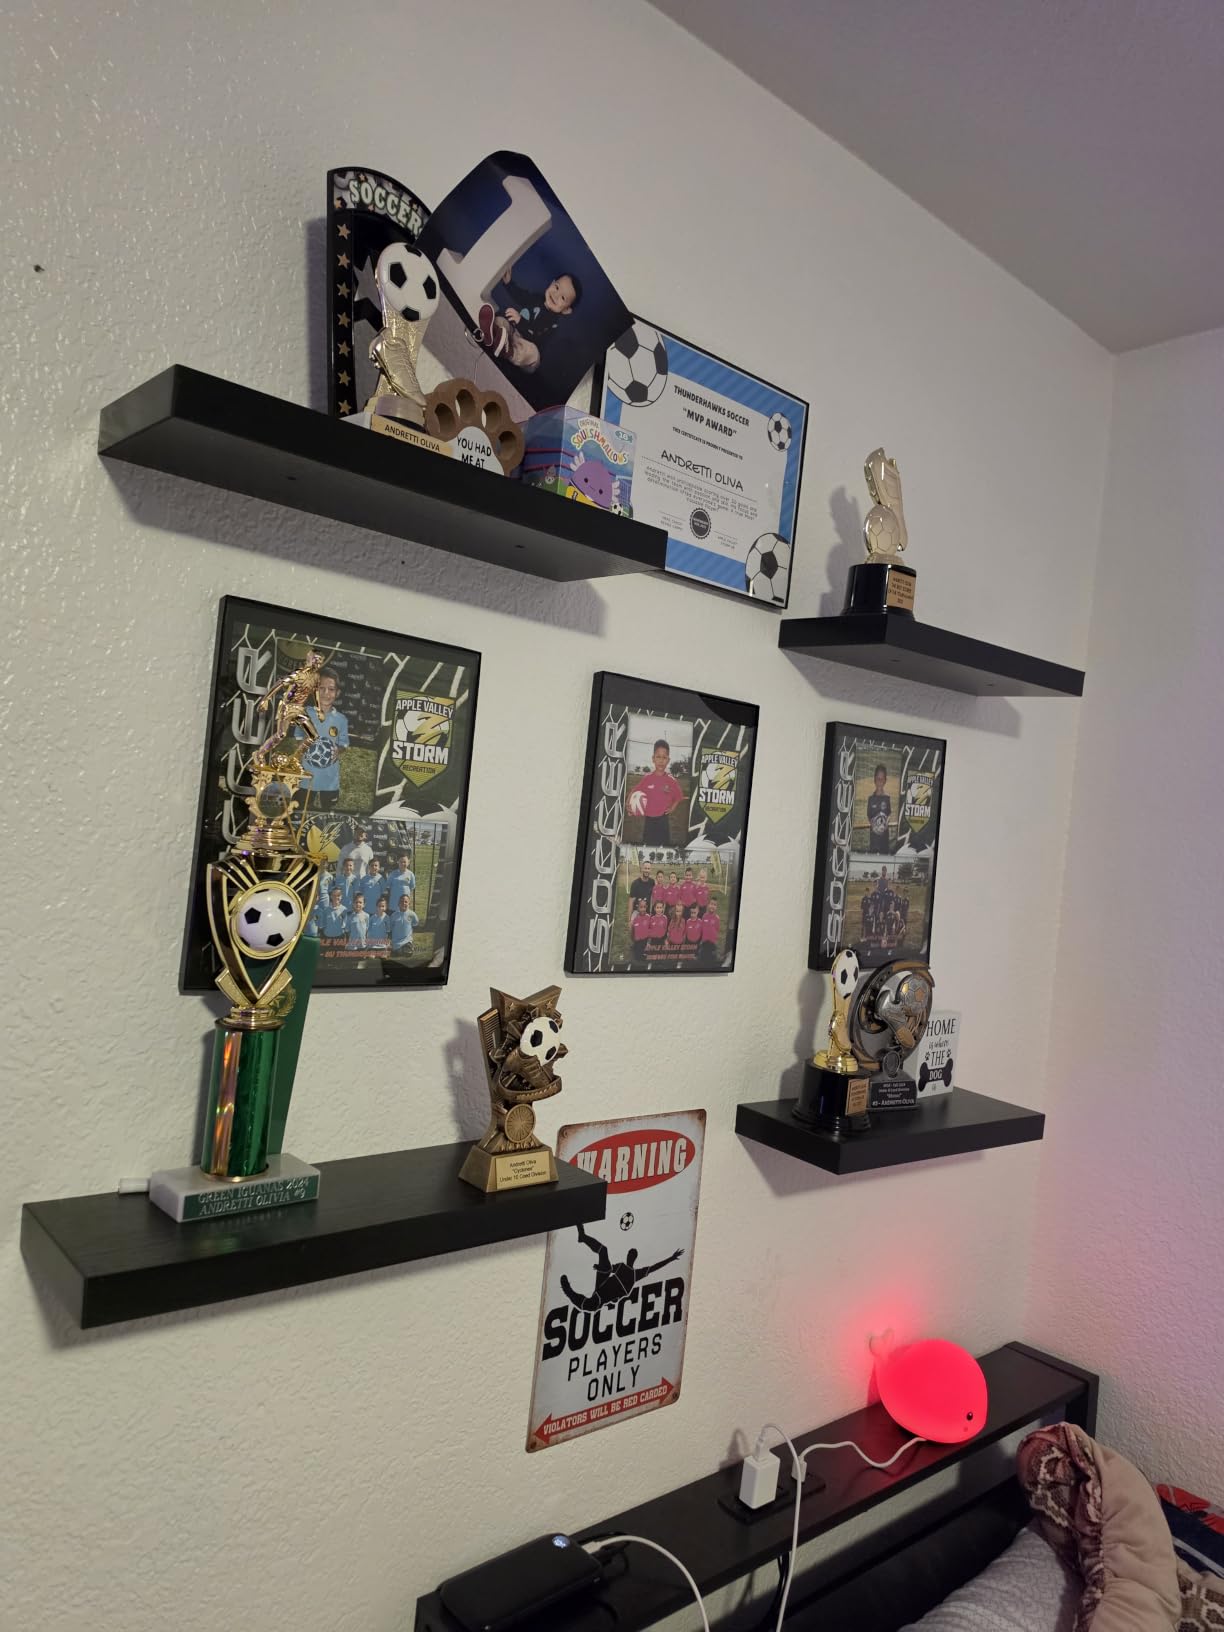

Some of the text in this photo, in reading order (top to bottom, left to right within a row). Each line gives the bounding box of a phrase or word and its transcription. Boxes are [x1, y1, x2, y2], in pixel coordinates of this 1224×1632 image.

[350, 181, 422, 239] SOCCER
[674, 385, 750, 427] THUNDERHAWKS SOCCER
[385, 424, 440, 452] ANDRETTI OLIVA
[457, 436, 492, 457] YOU HAD
[572, 429, 627, 462] SQUISHMALLOWS
[461, 454, 485, 469] ME AT
[661, 450, 744, 492] ANDRETTI OLIVA
[396, 699, 453, 718] APPLE VALLEY
[392, 741, 449, 765] STORM
[702, 754, 737, 768] APPLE VALLEY
[699, 788, 735, 805] STORM
[905, 804, 931, 817] STORM
[926, 1019, 956, 1037] HOME
[931, 1050, 945, 1066] THE
[929, 1070, 943, 1081] DOG
[577, 1138, 687, 1183] WARNING
[198, 1188, 234, 1203] GREEN
[237, 1182, 284, 1197] IGUANAS
[199, 1197, 252, 1215] ANDRETTI
[542, 1276, 685, 1361] SOCCER
[568, 1333, 662, 1381] PLAYERS
[587, 1364, 640, 1401] ONLY
[543, 1386, 667, 1435] VIOLATORS WILL BE RED CARDED
